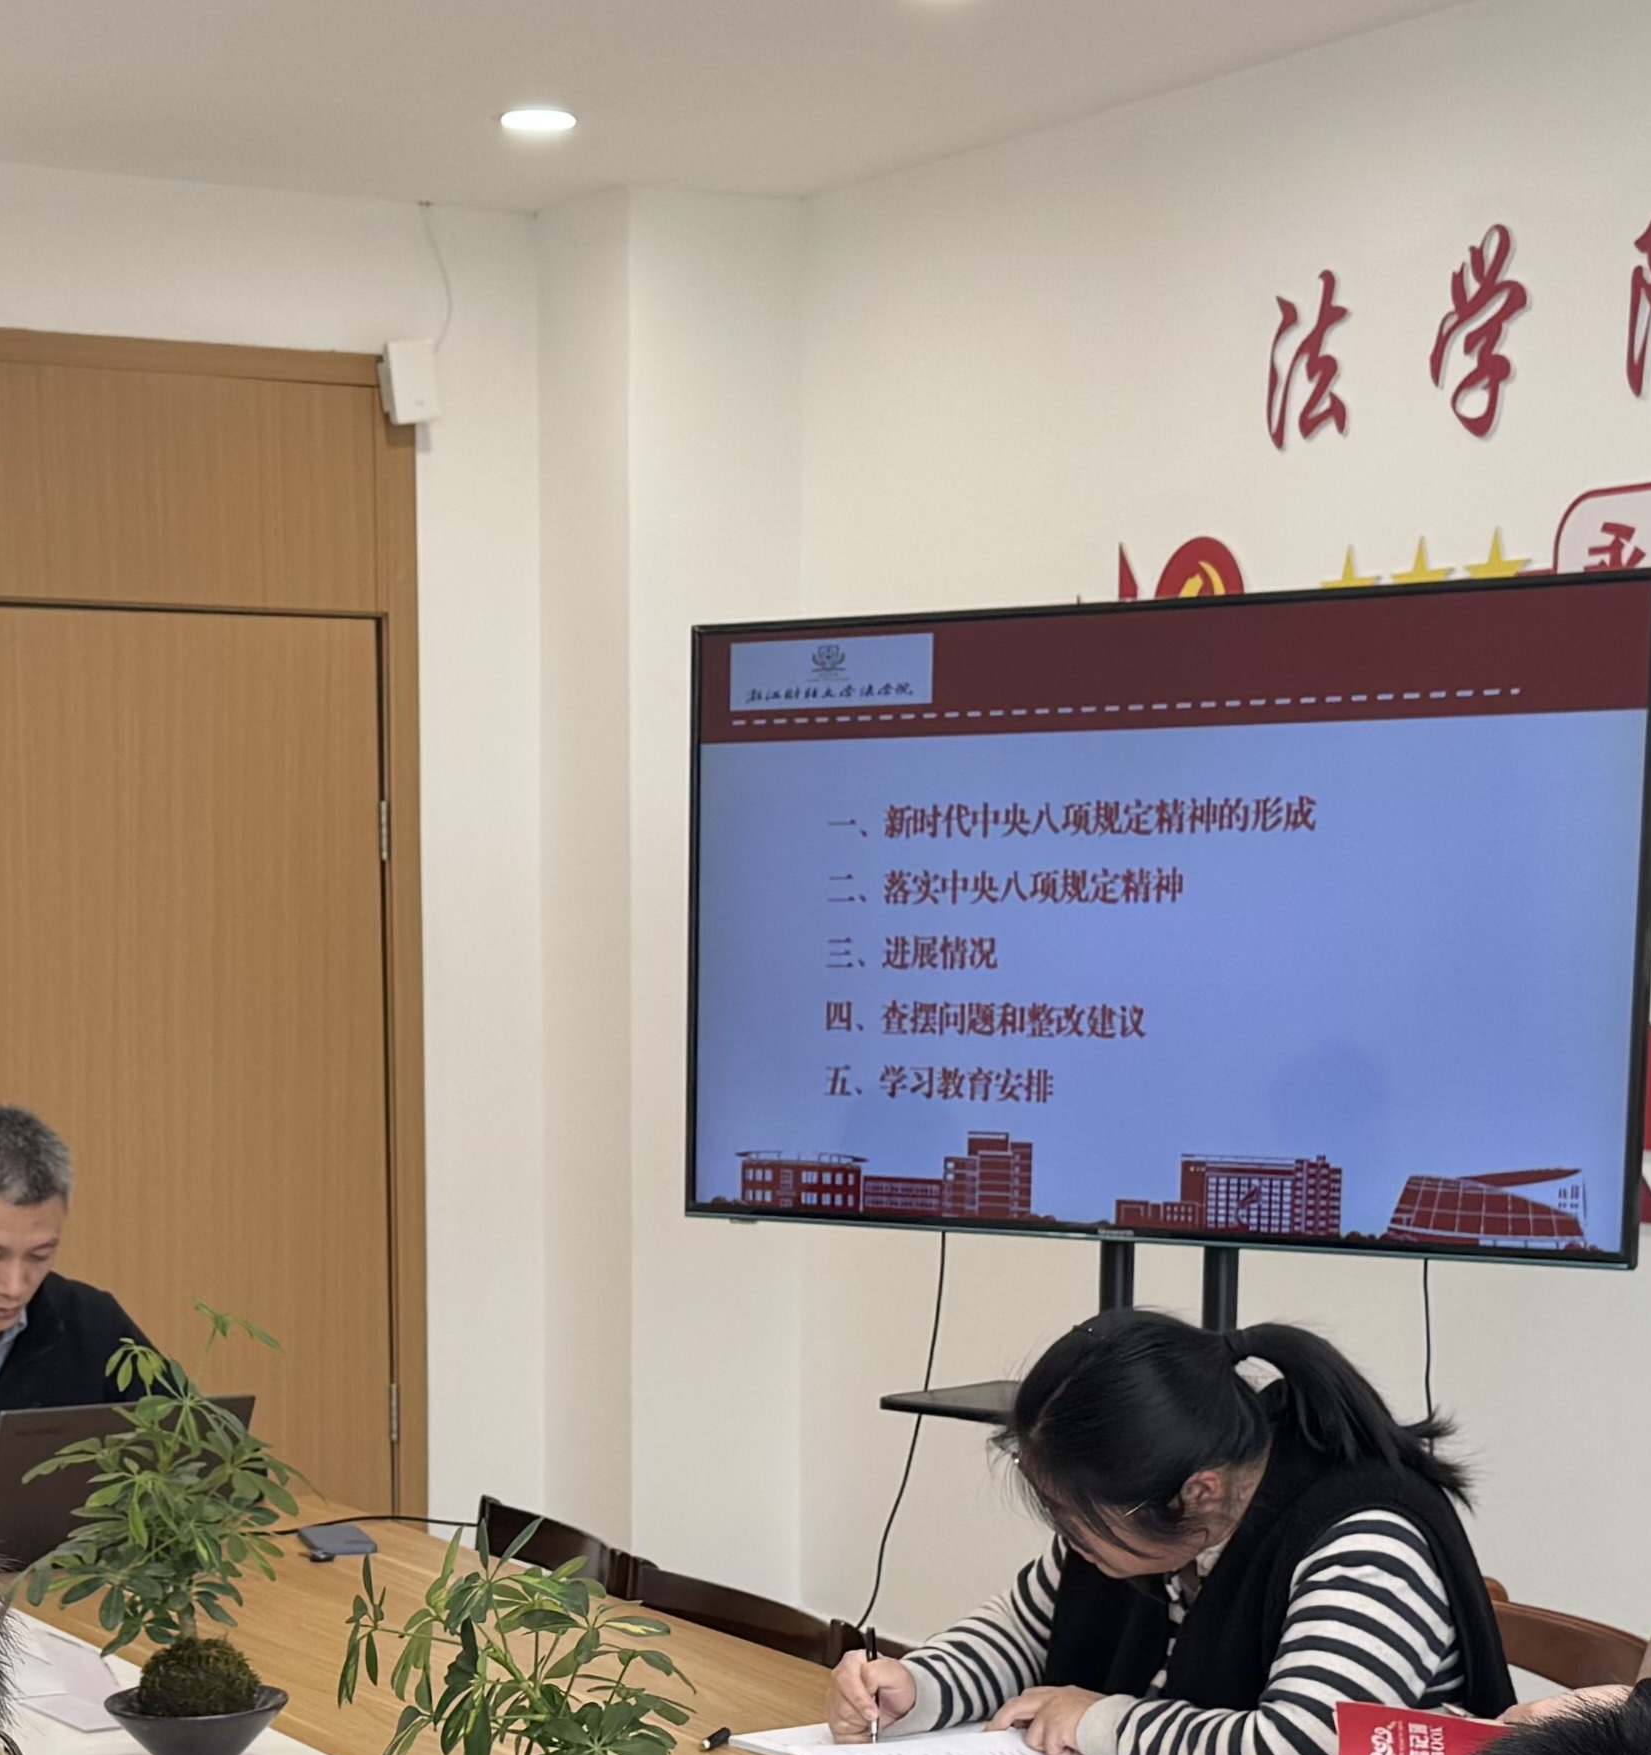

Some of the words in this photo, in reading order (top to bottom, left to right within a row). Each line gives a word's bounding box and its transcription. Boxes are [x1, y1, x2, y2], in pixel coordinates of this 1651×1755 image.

[827, 795, 1317, 840] 一、新时代中央八项规定精神的形成
[826, 867, 1184, 906] 二、落实中央八项规定精神
[825, 935, 999, 971] 三、进展情况
[825, 1000, 1146, 1040] 四、查摆问题和整改建议
[823, 1065, 1054, 1104] 五、学习教育安排
